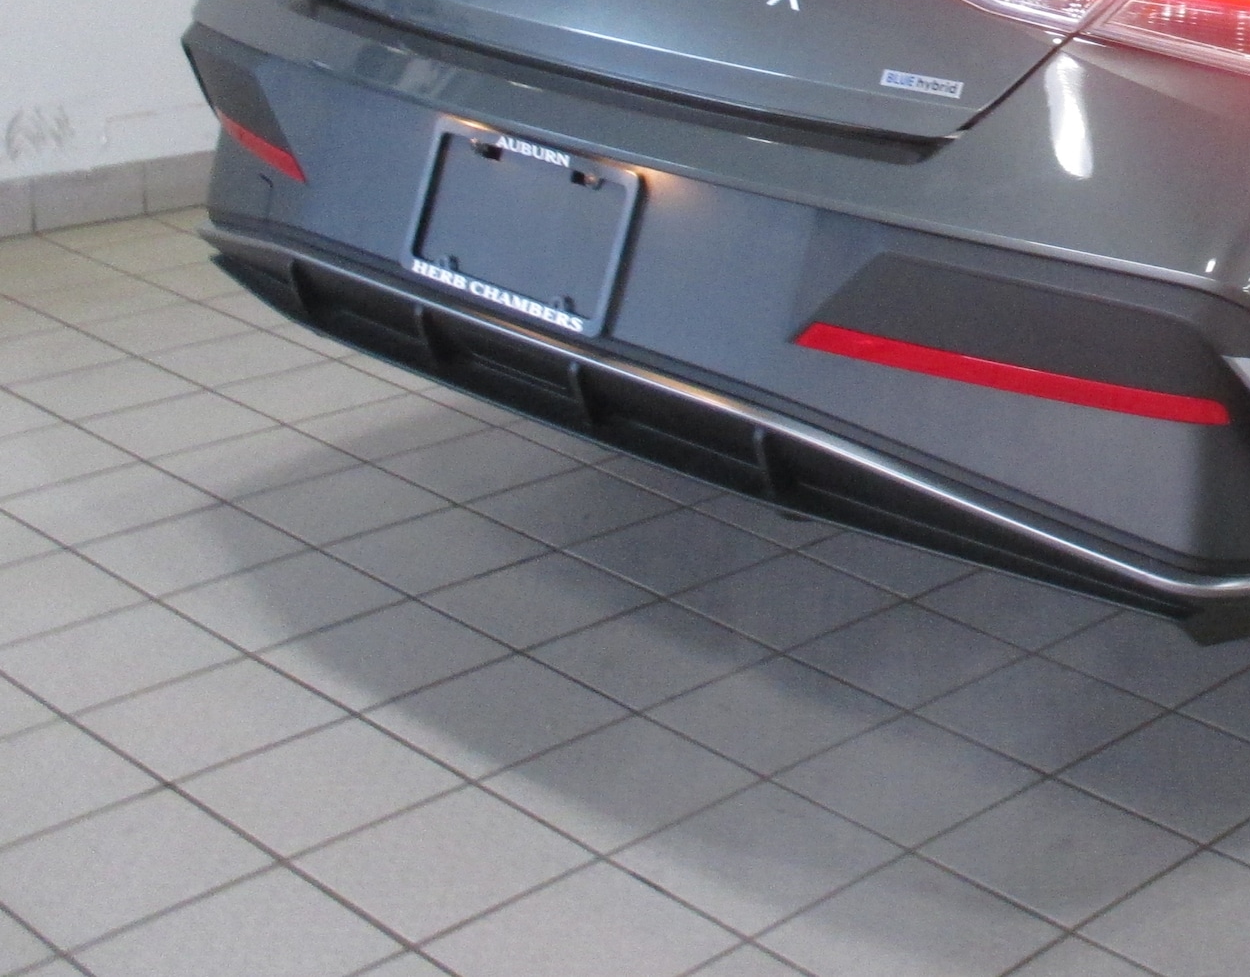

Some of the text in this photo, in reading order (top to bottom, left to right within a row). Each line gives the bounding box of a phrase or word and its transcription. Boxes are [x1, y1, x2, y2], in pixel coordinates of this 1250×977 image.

[886, 72, 958, 94] BLUE hybrid
[496, 135, 571, 168] AUBURN
[411, 259, 584, 333] HERB CHAMBERS
